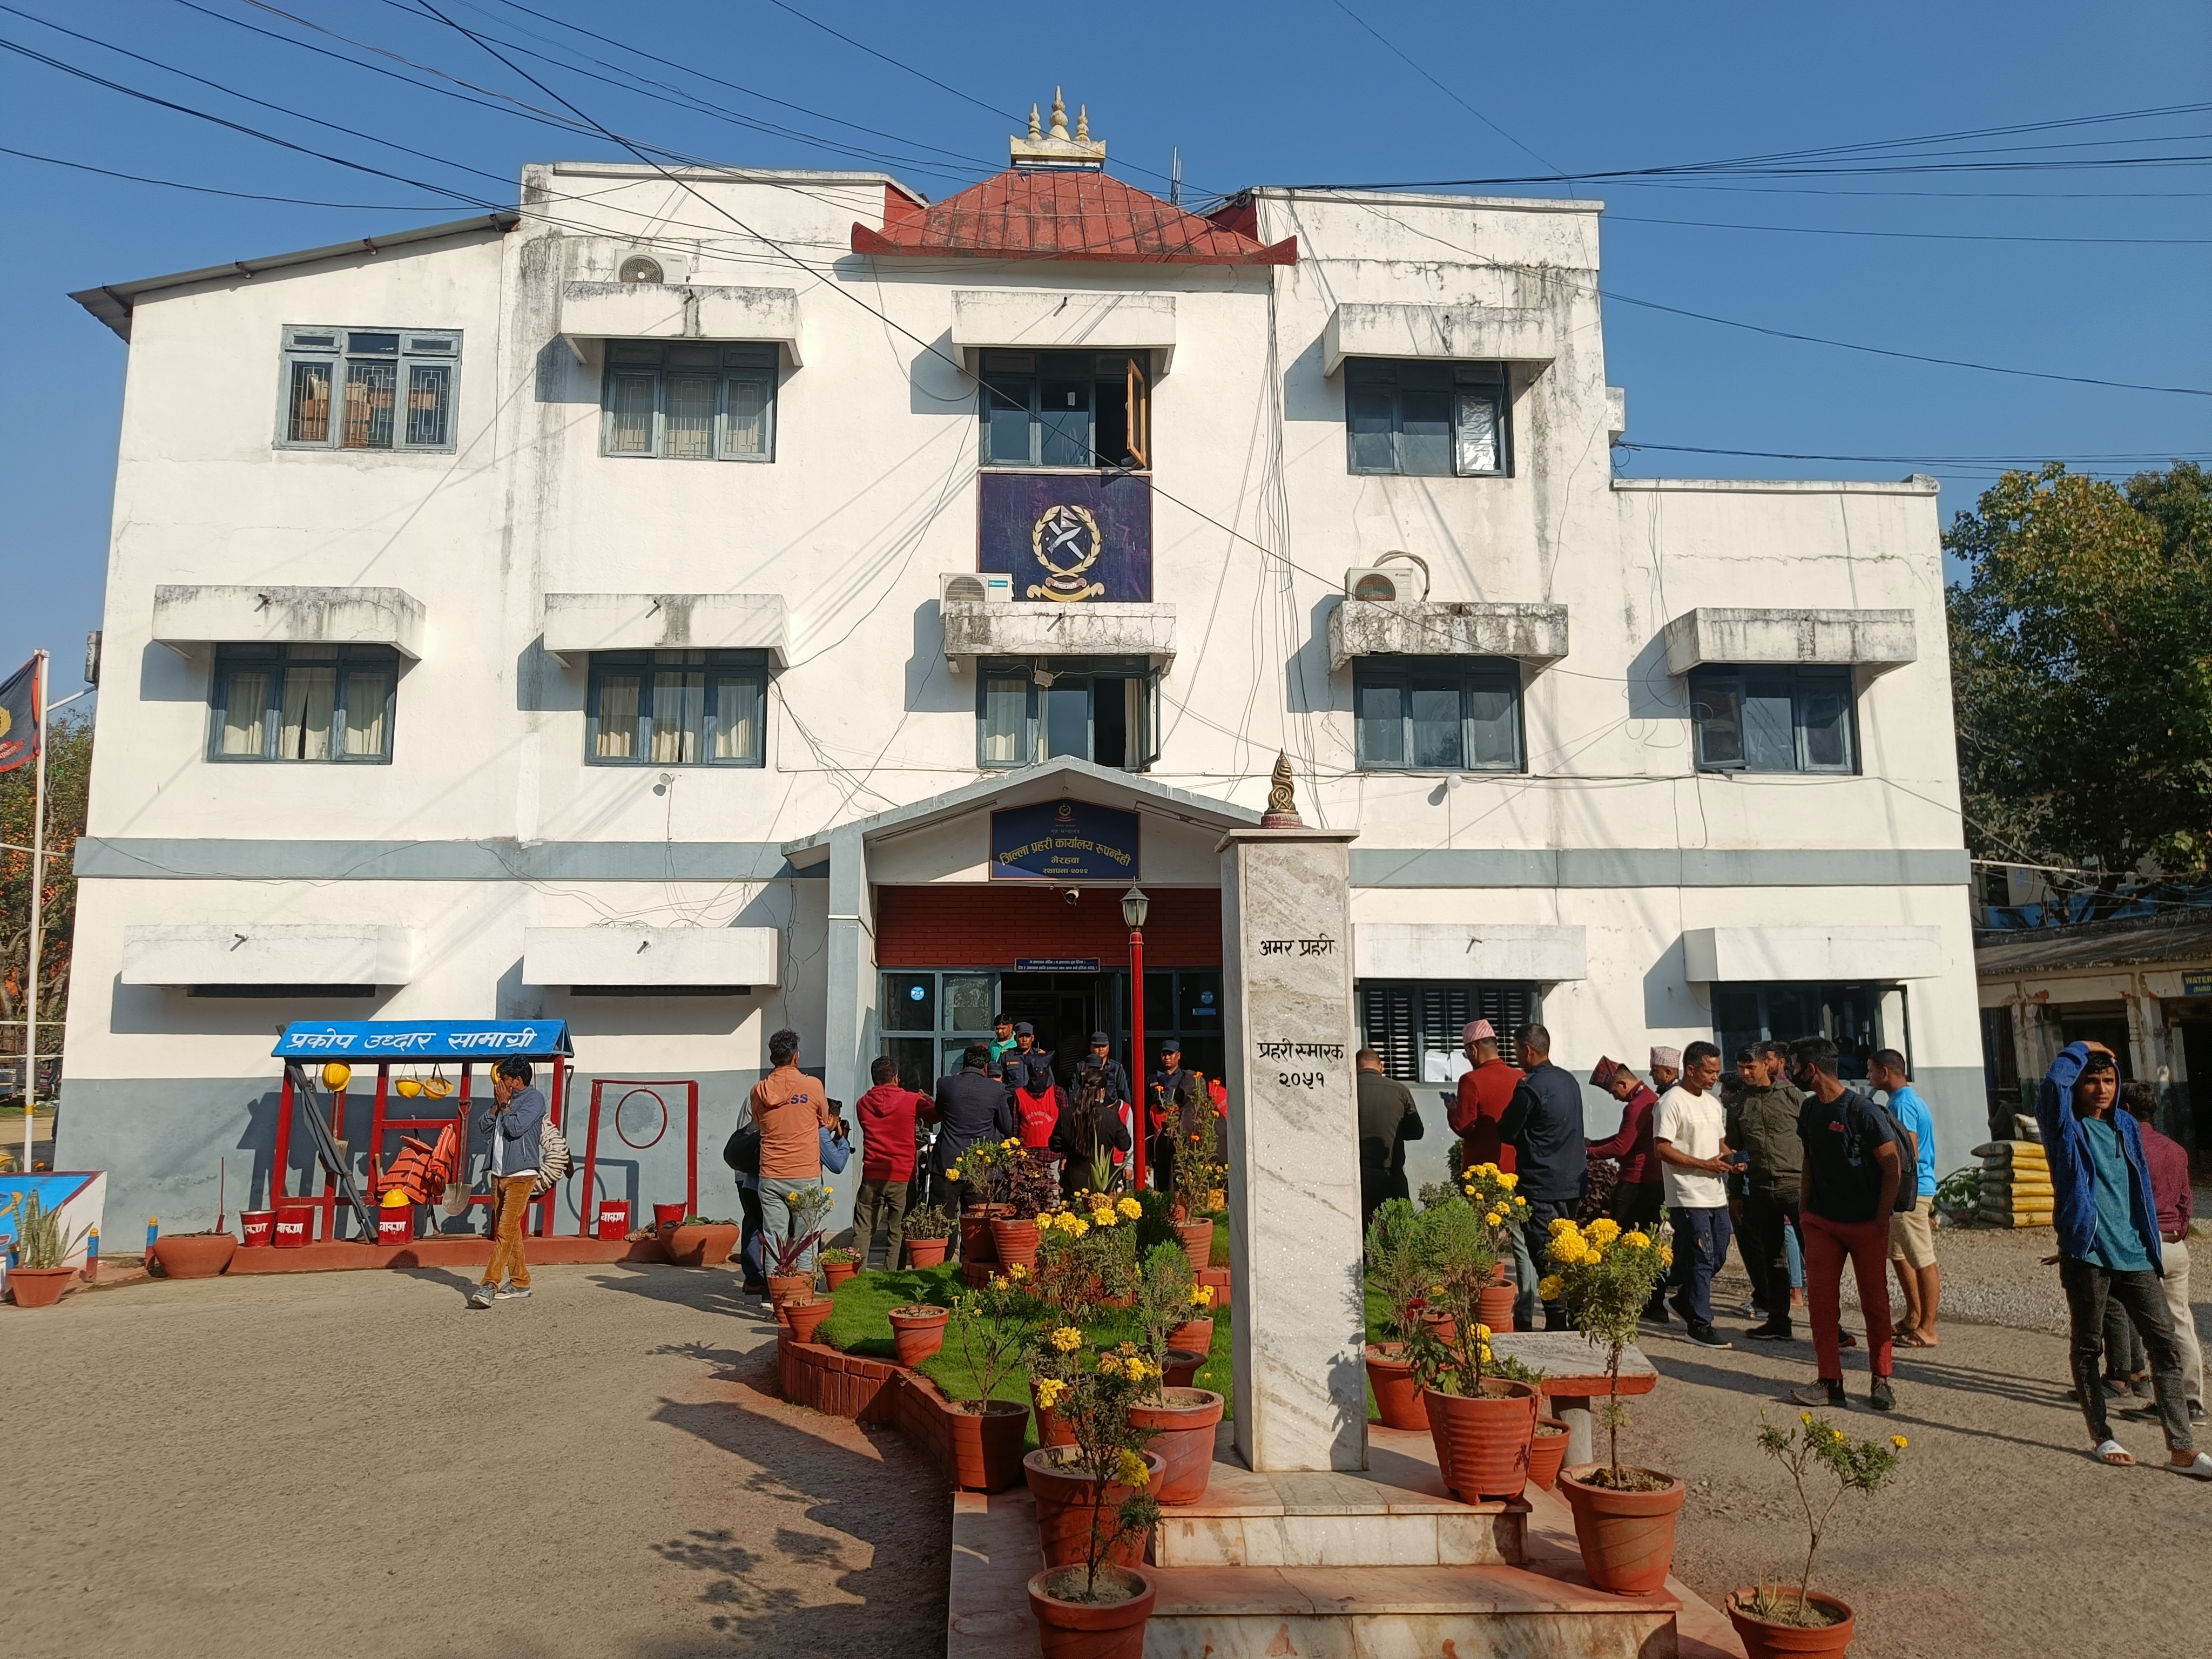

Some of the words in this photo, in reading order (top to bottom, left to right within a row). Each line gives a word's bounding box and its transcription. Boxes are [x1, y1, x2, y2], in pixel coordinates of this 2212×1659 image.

[999, 845, 1029, 866] जिल्ला
[1031, 837, 1053, 854] प्रहरी
[1055, 837, 1094, 851] कार्यालय
[1259, 940, 1294, 956] अमर
[1298, 933, 1335, 959] प्रहरी
[286, 1028, 358, 1049] प्रकोप
[448, 1027, 537, 1050] सामाग्री
[1257, 1037, 1294, 1063] प्रहरी
[1296, 1043, 1344, 1064] स्मारक
[1279, 1072, 1325, 1090] २०५१
